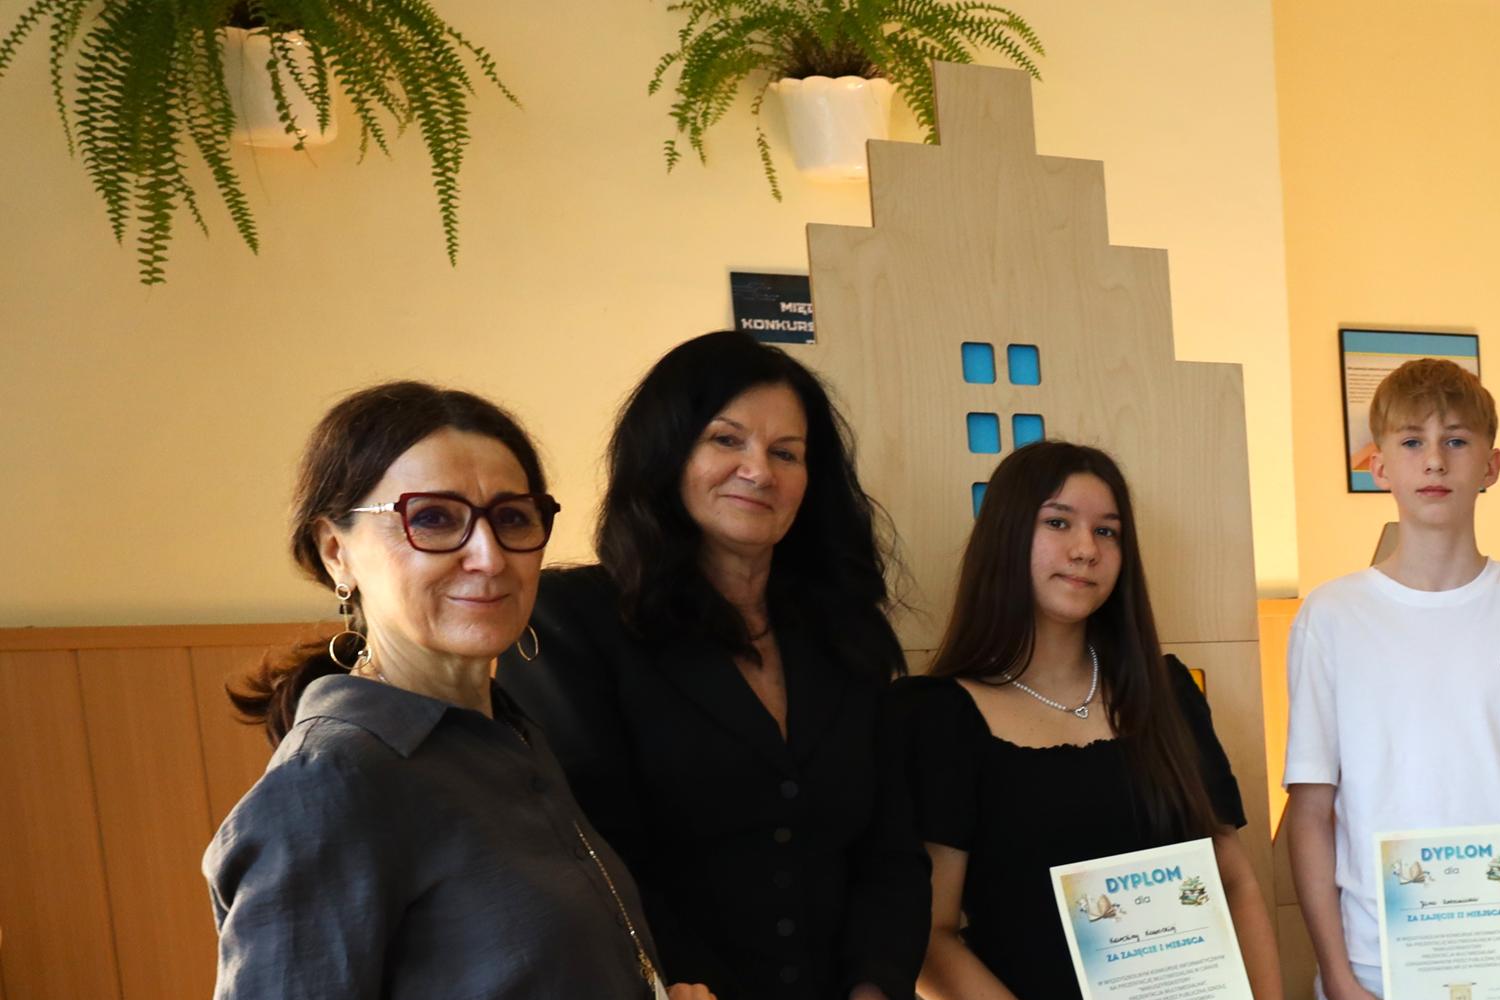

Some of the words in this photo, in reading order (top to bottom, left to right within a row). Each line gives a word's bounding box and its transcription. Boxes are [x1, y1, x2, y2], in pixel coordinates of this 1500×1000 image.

[1421, 843, 1493, 862] DYPLOM
[1444, 866, 1460, 876] dla
[1105, 865, 1182, 894] DYPLOM
[1134, 895, 1151, 905] dla
[1407, 914, 1418, 922] ZA
[1106, 953, 1119, 962] ZA
[1165, 936, 1205, 950] MIEJSCA
